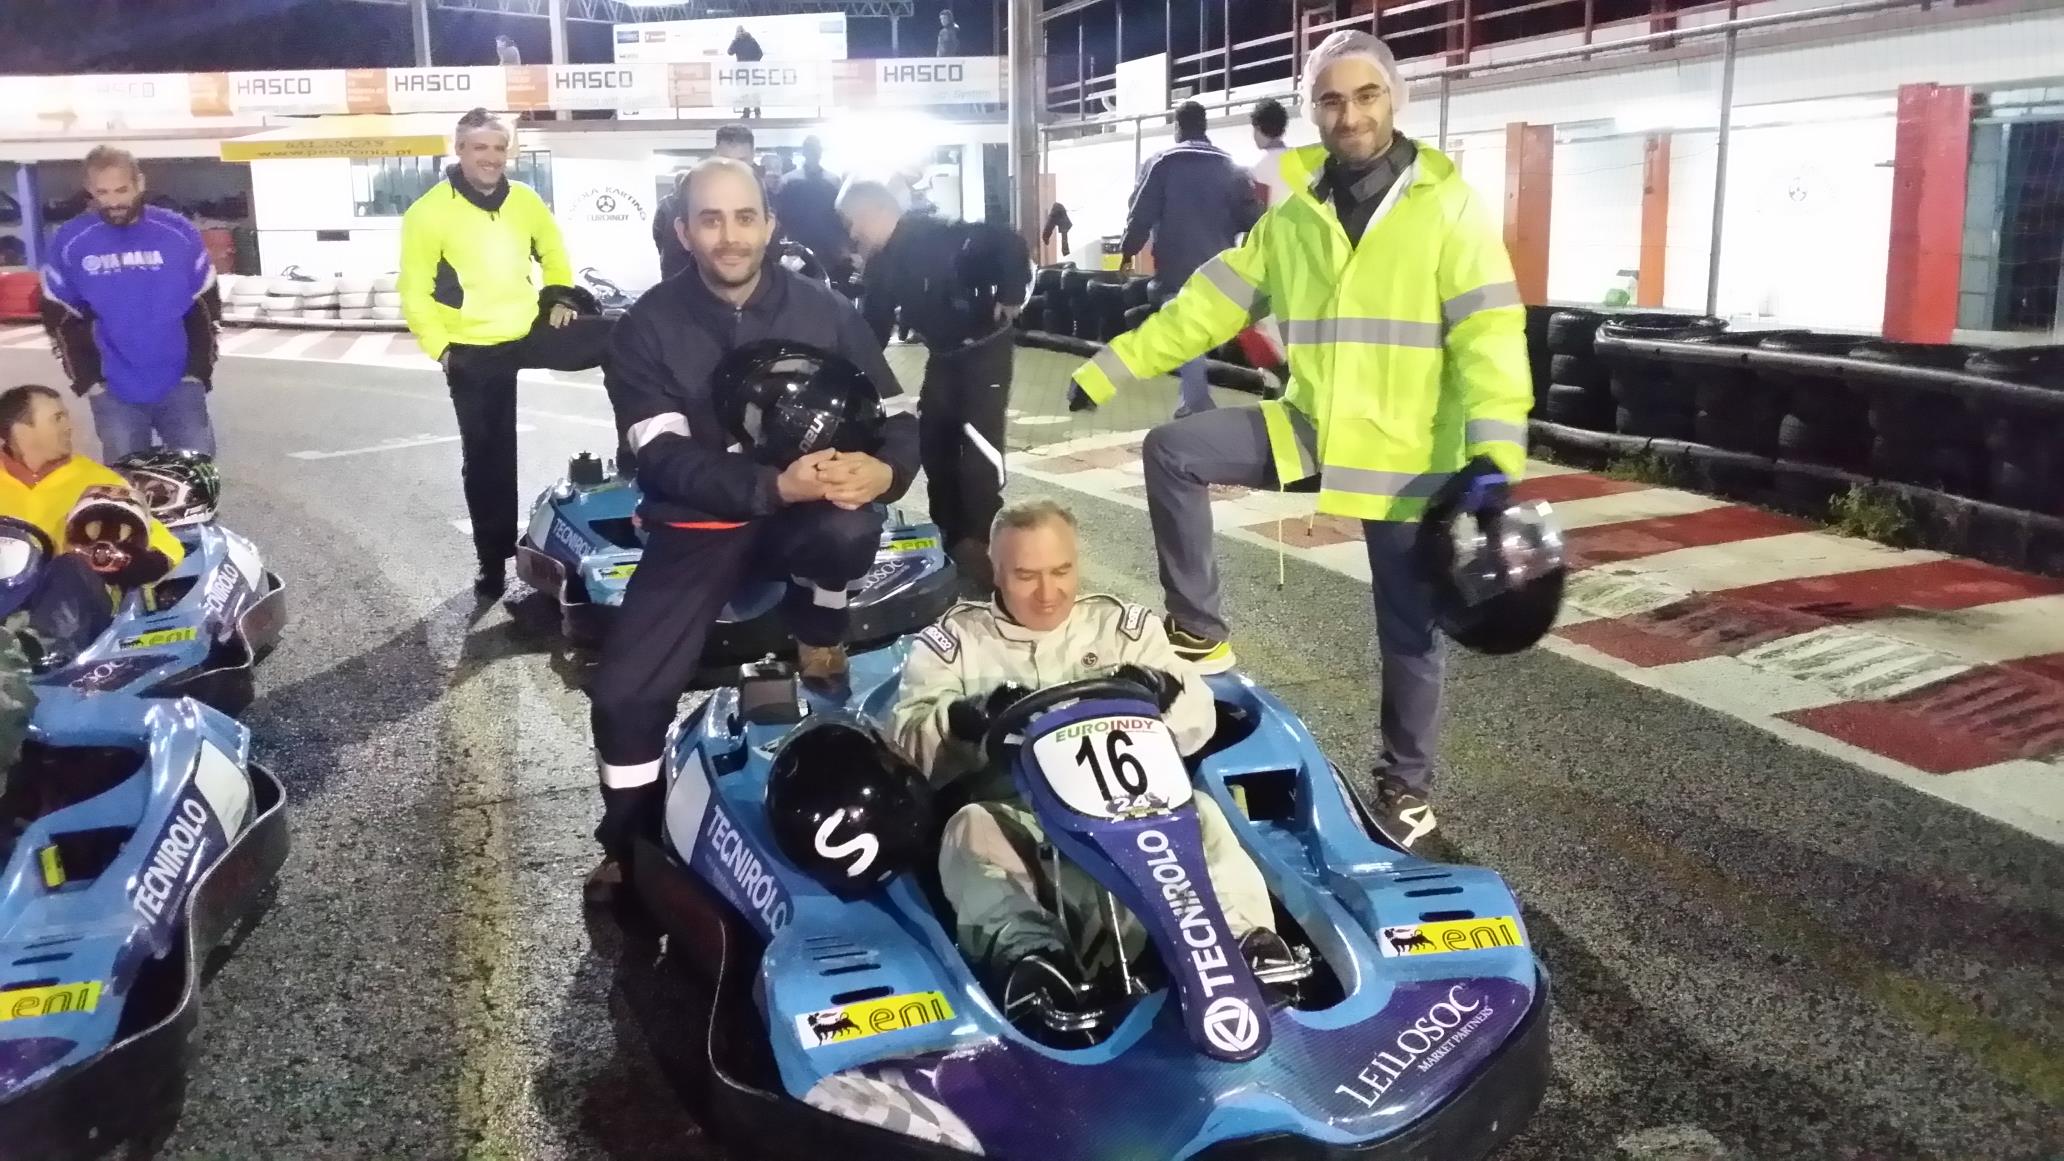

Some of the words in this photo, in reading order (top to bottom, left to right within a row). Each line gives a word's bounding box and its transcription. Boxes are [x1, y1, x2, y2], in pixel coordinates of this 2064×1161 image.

[237, 77, 312, 95] HASCO
[394, 74, 471, 91] HASCO
[555, 71, 633, 89] HASCO
[719, 69, 797, 86] HASCO
[884, 64, 963, 83] HASCO
[1055, 718, 1154, 743] EUROINDY
[1075, 729, 1148, 801] 16
[133, 799, 207, 925] TECNIROLO
[706, 804, 788, 937] TECNIROLO
[1136, 829, 1235, 998] TECNIROLO
[1442, 916, 1515, 952] eni
[11, 981, 91, 1019] eni
[868, 990, 946, 1035] eni
[1335, 984, 1480, 1109] LEILOSOC
[1417, 1037, 1454, 1073] MARKET
[1452, 1005, 1494, 1044] PARTNERS
